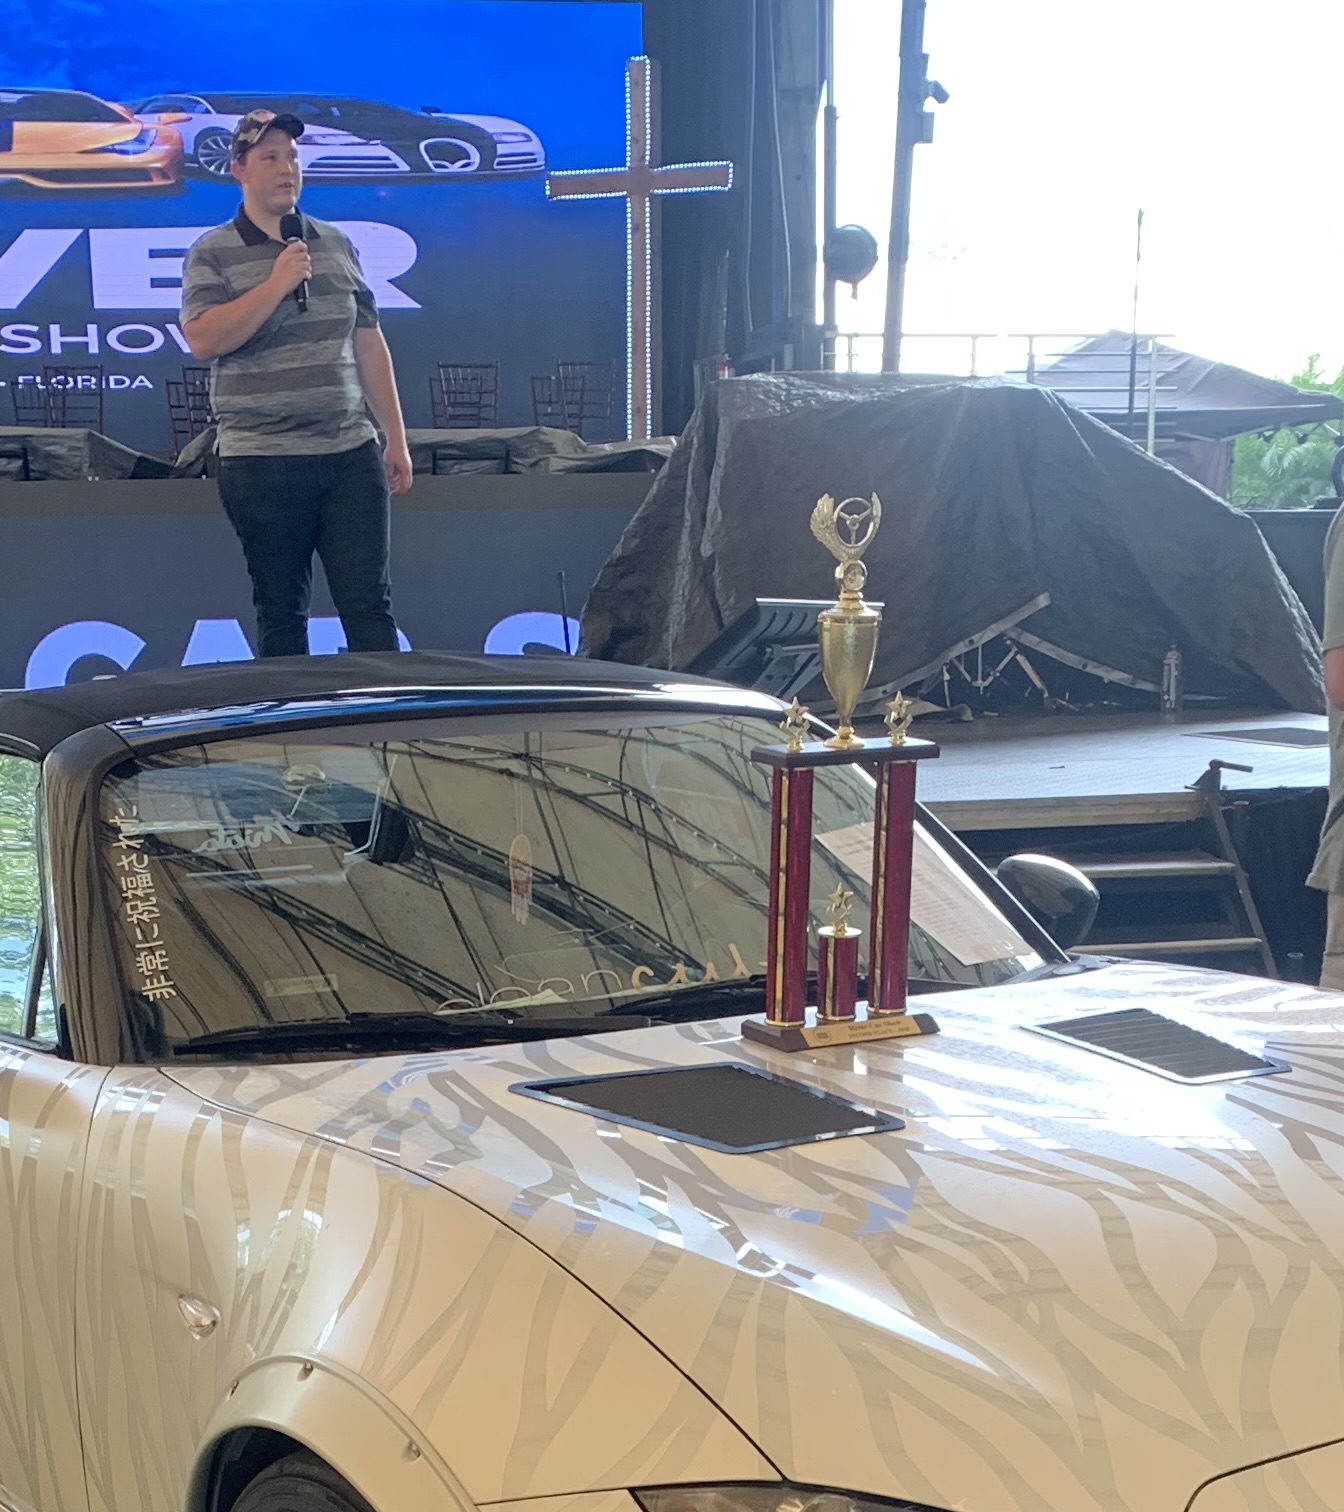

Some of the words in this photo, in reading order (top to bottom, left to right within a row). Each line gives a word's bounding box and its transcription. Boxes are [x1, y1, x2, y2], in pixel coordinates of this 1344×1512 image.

[17, 374, 154, 390] FLORIDA
[109, 804, 178, 1001] 非常に祝福された
